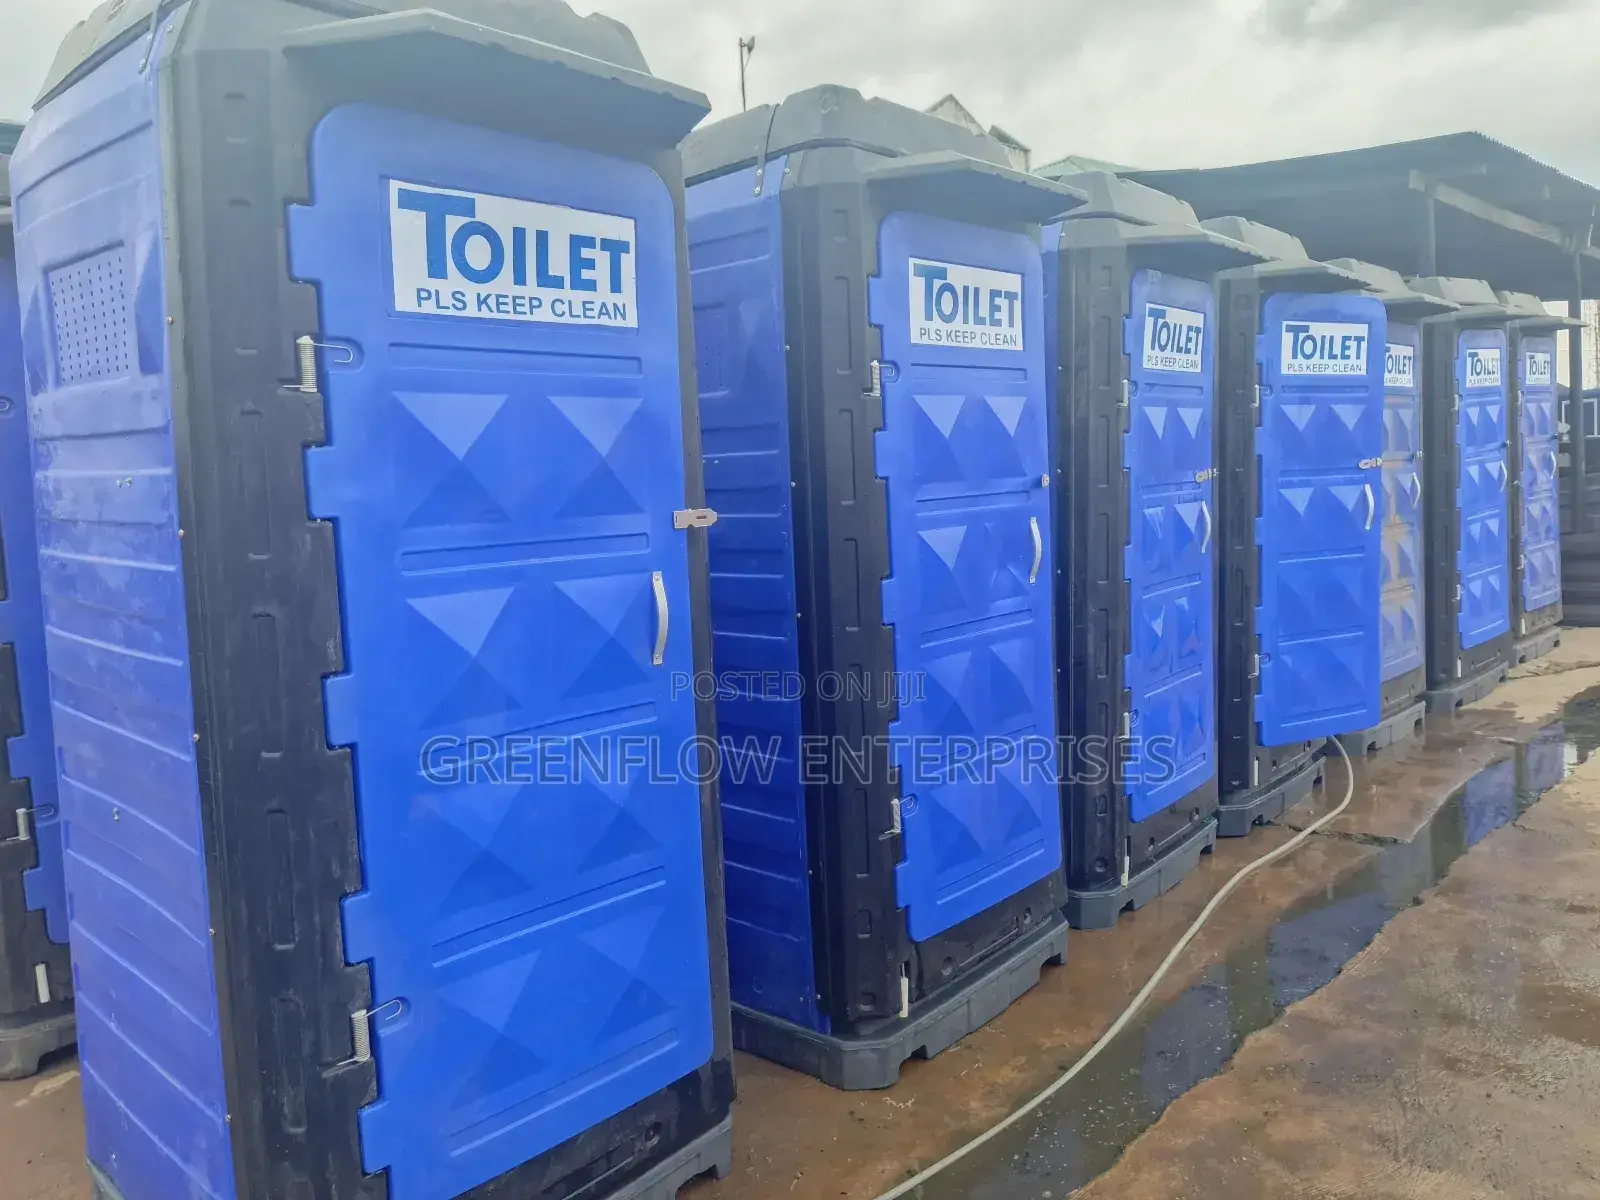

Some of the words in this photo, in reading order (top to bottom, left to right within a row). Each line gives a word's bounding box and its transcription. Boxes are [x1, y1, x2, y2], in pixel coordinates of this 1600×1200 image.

[397, 187, 630, 294] TOILET
[416, 287, 467, 311] PLS
[476, 292, 543, 316] KEEP
[550, 298, 627, 322] CLEAN
[913, 262, 1019, 328] TOILET
[920, 327, 942, 342] PLS
[946, 329, 977, 344] KEEP
[980, 332, 1017, 346] CLEAN
[1147, 307, 1202, 355] TOILET
[1285, 324, 1365, 360] TOILET
[1147, 355, 1159, 367] PLS
[1160, 356, 1177, 368] KEEP
[1177, 358, 1199, 369] CLEAN
[1287, 363, 1304, 372] PLS
[1306, 363, 1329, 372] KEEP
[1332, 363, 1362, 373] CLEAN
[1468, 351, 1500, 376] TOILET
